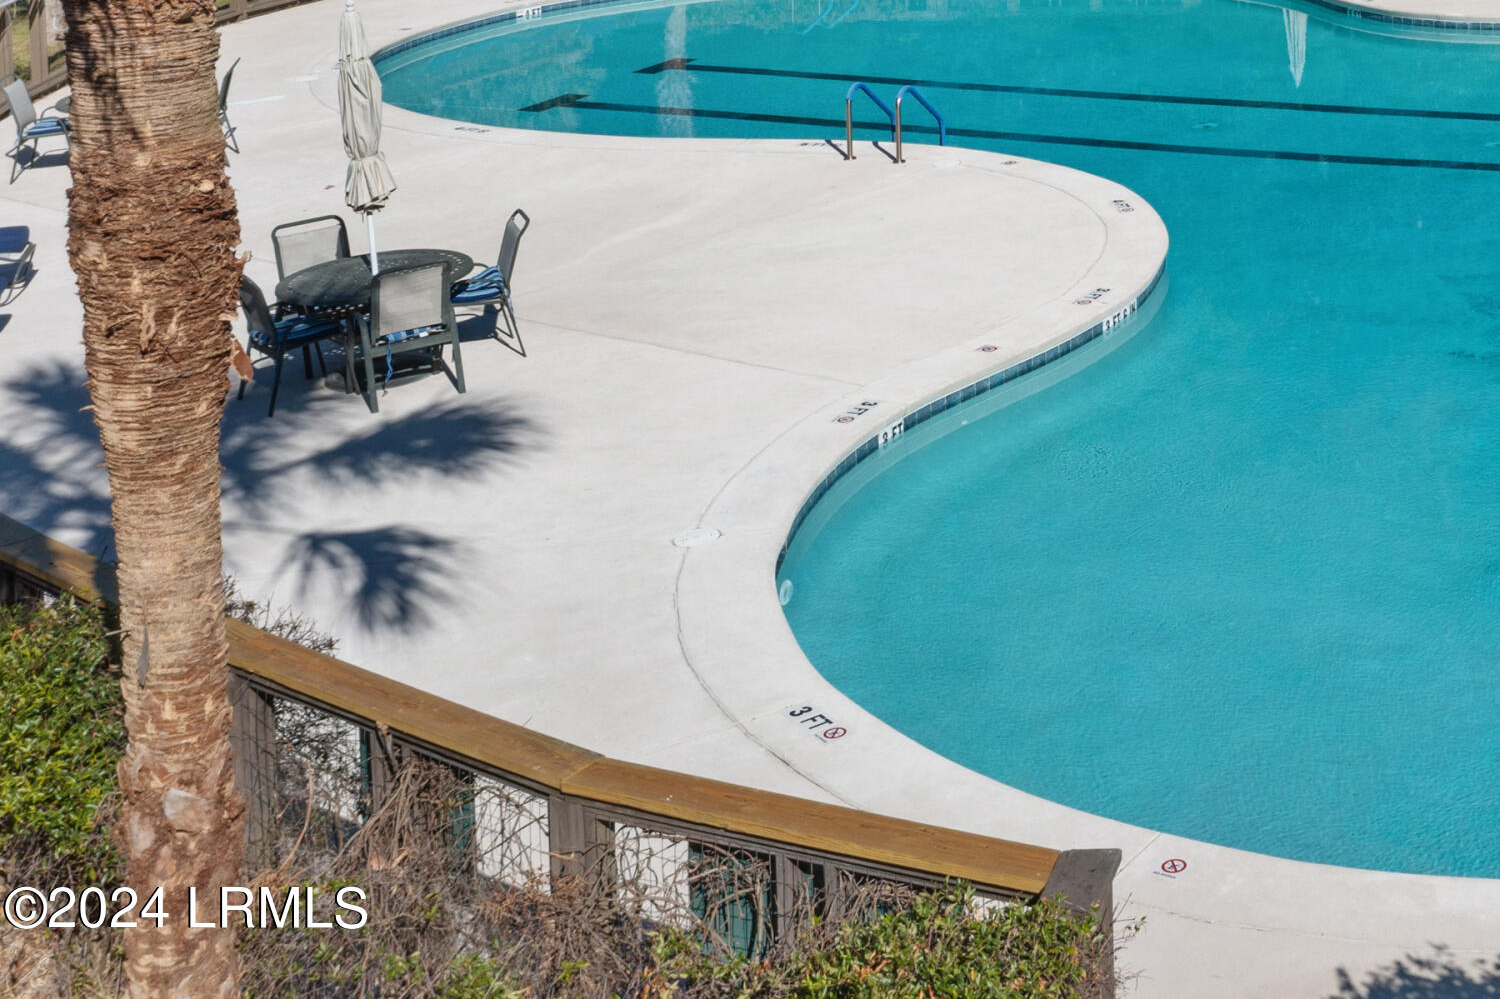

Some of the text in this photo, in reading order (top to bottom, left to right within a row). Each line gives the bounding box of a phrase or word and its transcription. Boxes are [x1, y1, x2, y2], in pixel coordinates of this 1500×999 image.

[847, 407, 869, 416] FT
[891, 422, 903, 439] FT
[789, 706, 833, 730] 3 FT
